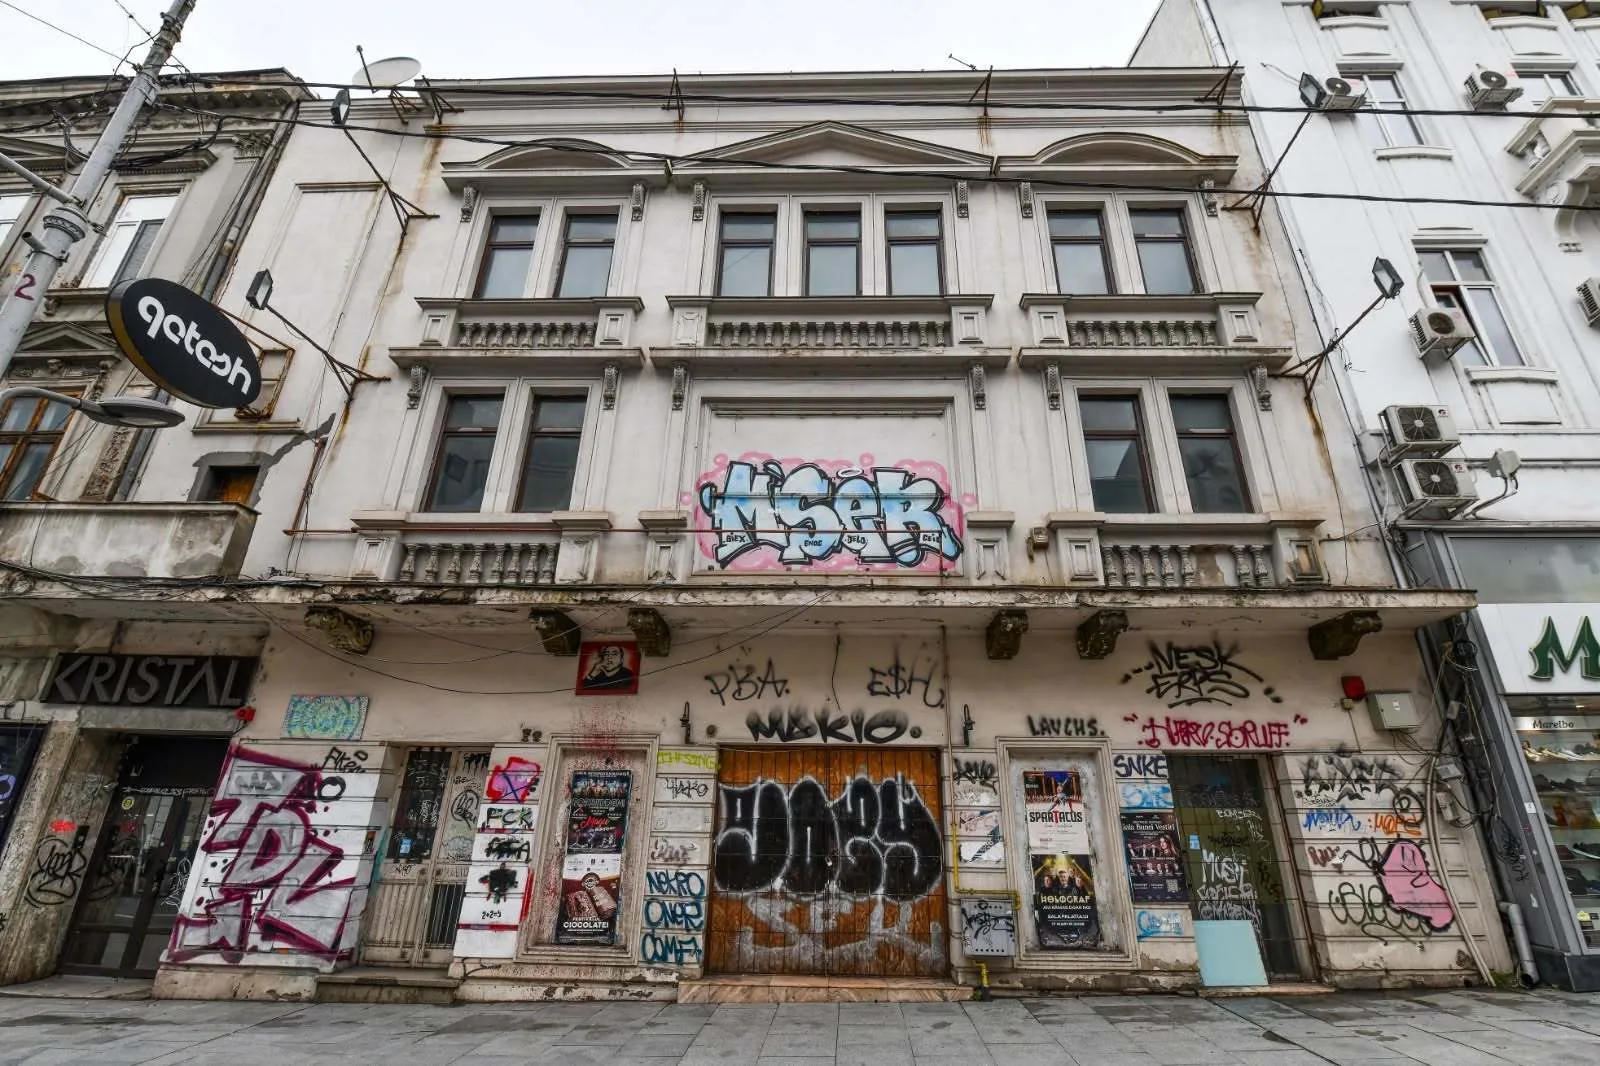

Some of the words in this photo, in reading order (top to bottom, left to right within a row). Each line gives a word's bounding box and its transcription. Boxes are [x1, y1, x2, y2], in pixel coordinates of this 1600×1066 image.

[14, 273, 37, 301] 2
[53, 656, 243, 706] KRISTAL
[1113, 754, 1169, 778] SNKE
[1029, 810, 1083, 824] SPARTACUS
[563, 920, 609, 929] CIOCOLATEI
